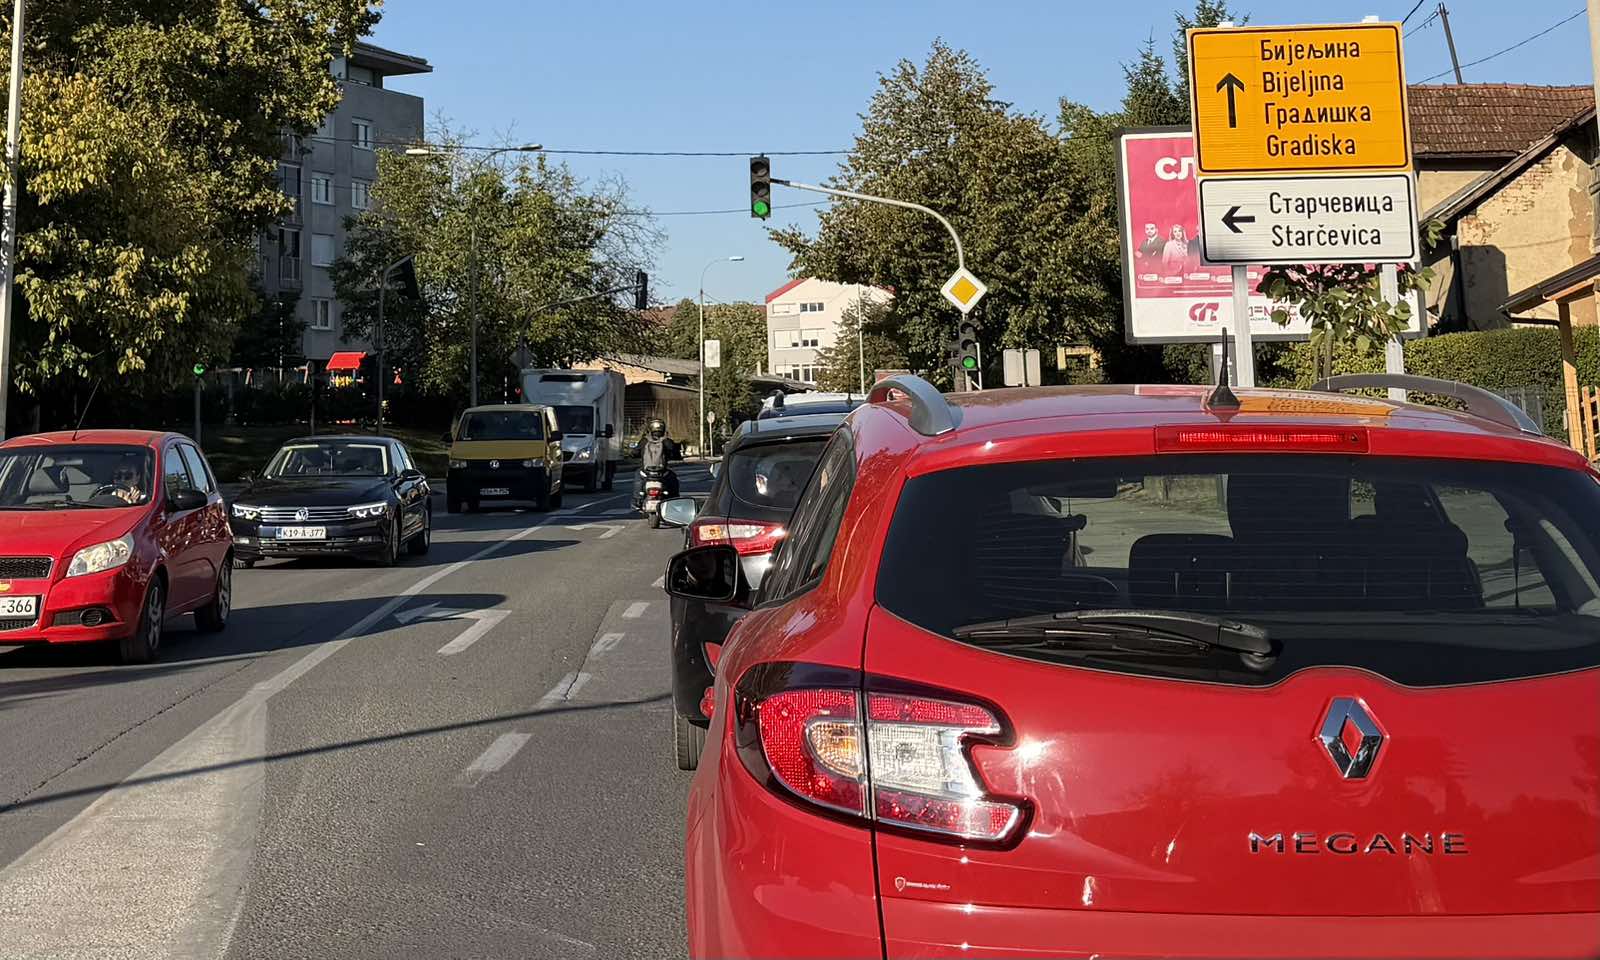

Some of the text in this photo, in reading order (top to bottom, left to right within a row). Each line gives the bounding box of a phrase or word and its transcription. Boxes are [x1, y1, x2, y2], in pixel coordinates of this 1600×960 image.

[1260, 39, 1360, 66] Бијељина
[1264, 102, 1371, 130] Градишка
[1267, 133, 1356, 156] Gradiska
[1269, 191, 1393, 219] Старчевица
[1272, 223, 1381, 247] Starčevica
[1248, 832, 1469, 855] MEGANE
